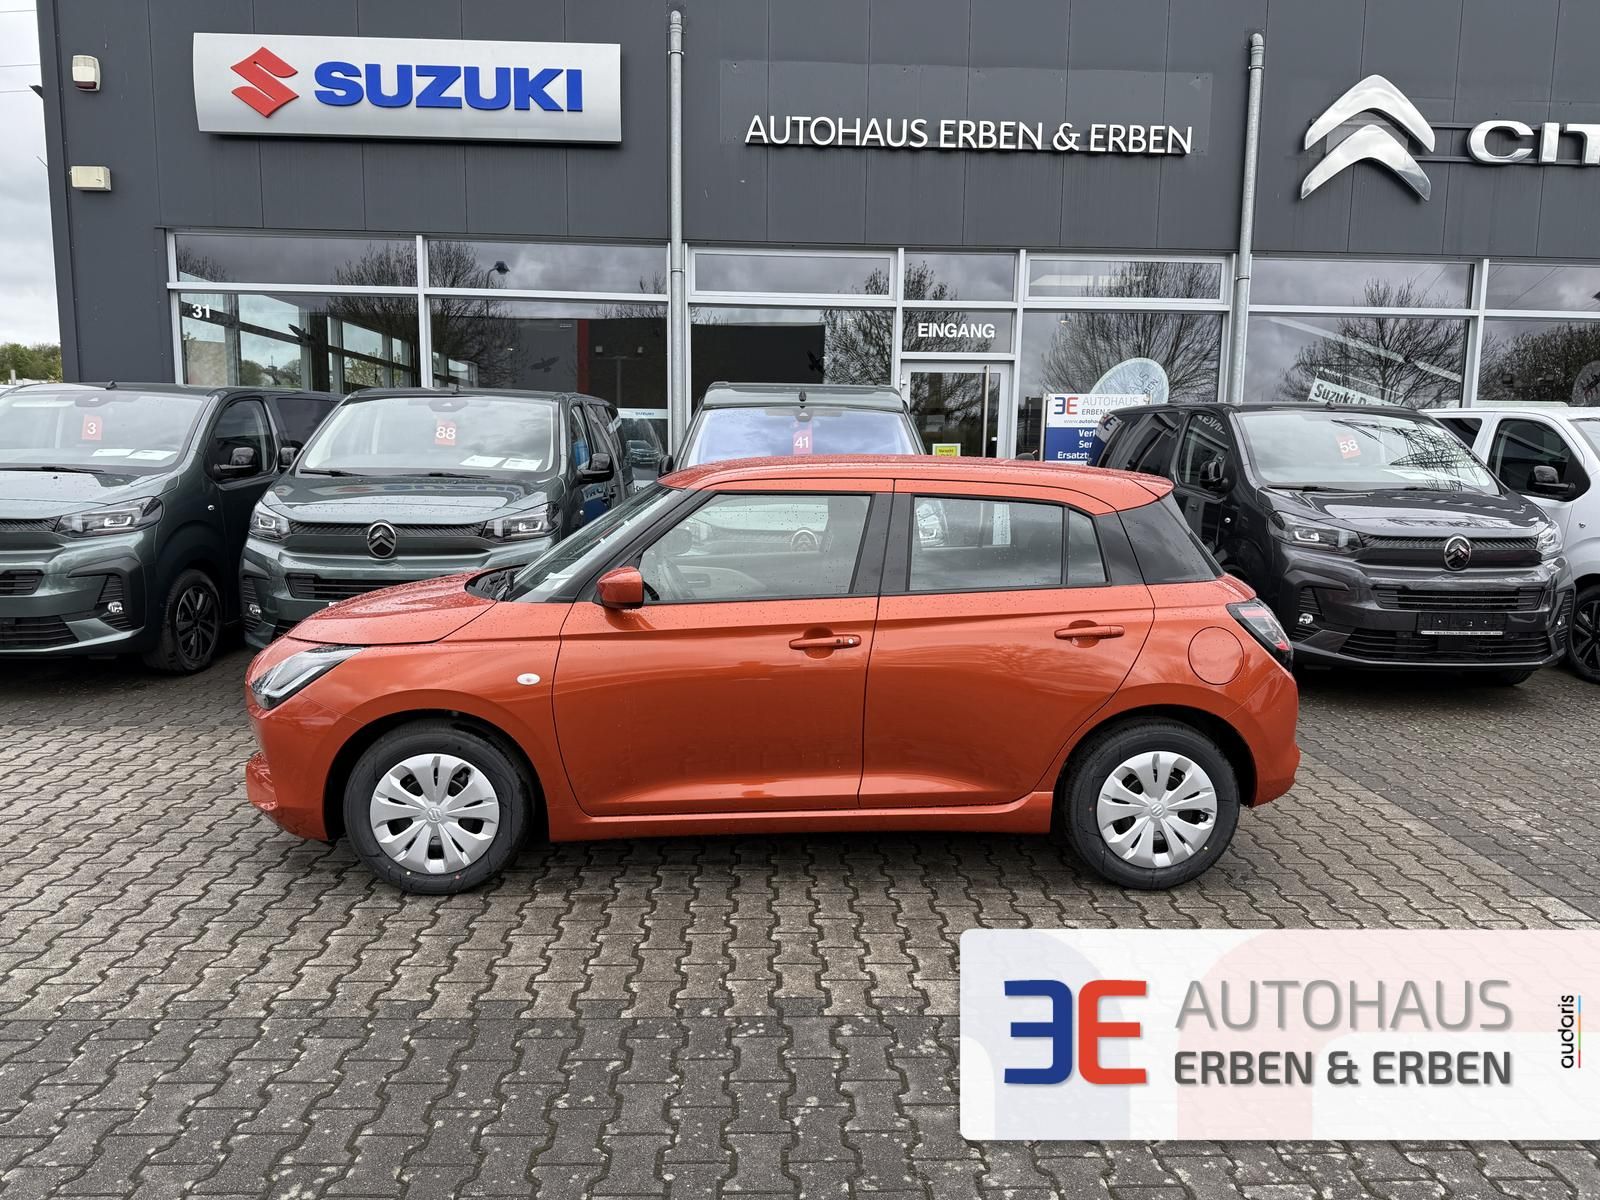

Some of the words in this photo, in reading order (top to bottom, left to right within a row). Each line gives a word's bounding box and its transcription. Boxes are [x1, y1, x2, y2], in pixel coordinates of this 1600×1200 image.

[314, 61, 583, 112] SUZUKI
[744, 114, 929, 148] AUTOHAUS
[939, 119, 1043, 150] ERBEN
[1052, 122, 1081, 151] &
[1089, 123, 1193, 154] ERBEN
[1467, 120, 1600, 164] CIT
[192, 303, 210, 319] 31
[917, 322, 996, 339] EINGANG
[1082, 396, 1139, 406] AUTOHAUS
[1314, 383, 1356, 405] Suzuki
[87, 422, 97, 435] 3
[435, 426, 456, 440] 88
[795, 436, 809, 449] 41
[1078, 440, 1092, 449] Ser
[1340, 439, 1359, 453] 58
[1057, 451, 1089, 460] Ersatzt
